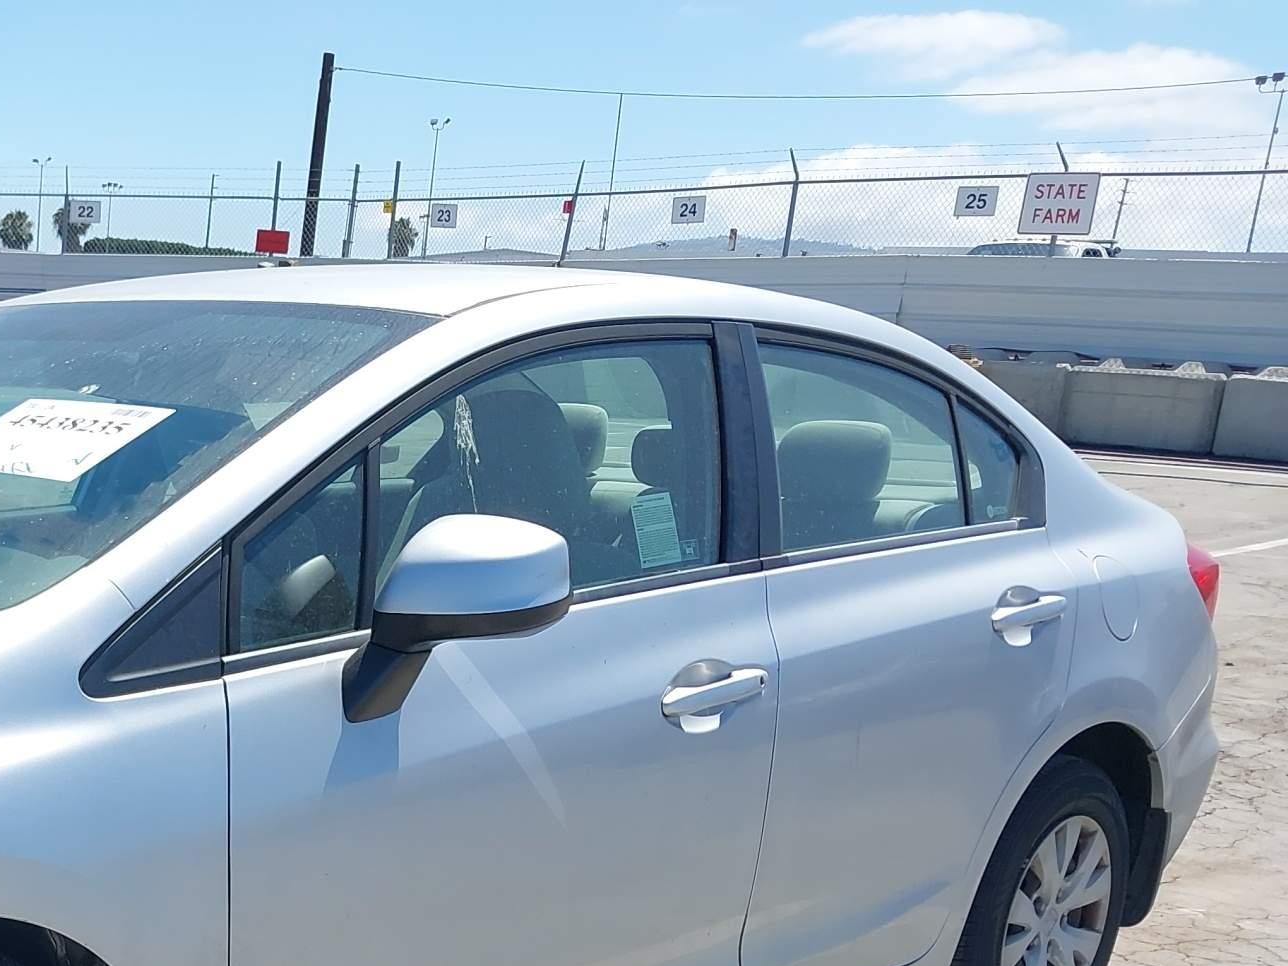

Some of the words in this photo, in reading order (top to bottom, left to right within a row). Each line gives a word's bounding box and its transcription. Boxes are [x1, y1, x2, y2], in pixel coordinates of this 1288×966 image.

[1034, 184, 1088, 200] STATE
[965, 193, 987, 209] 25
[78, 204, 94, 217] 22
[437, 209, 451, 223] 23
[680, 203, 697, 217] 24
[1032, 208, 1080, 224] FARM
[9, 414, 131, 435] 45438235
